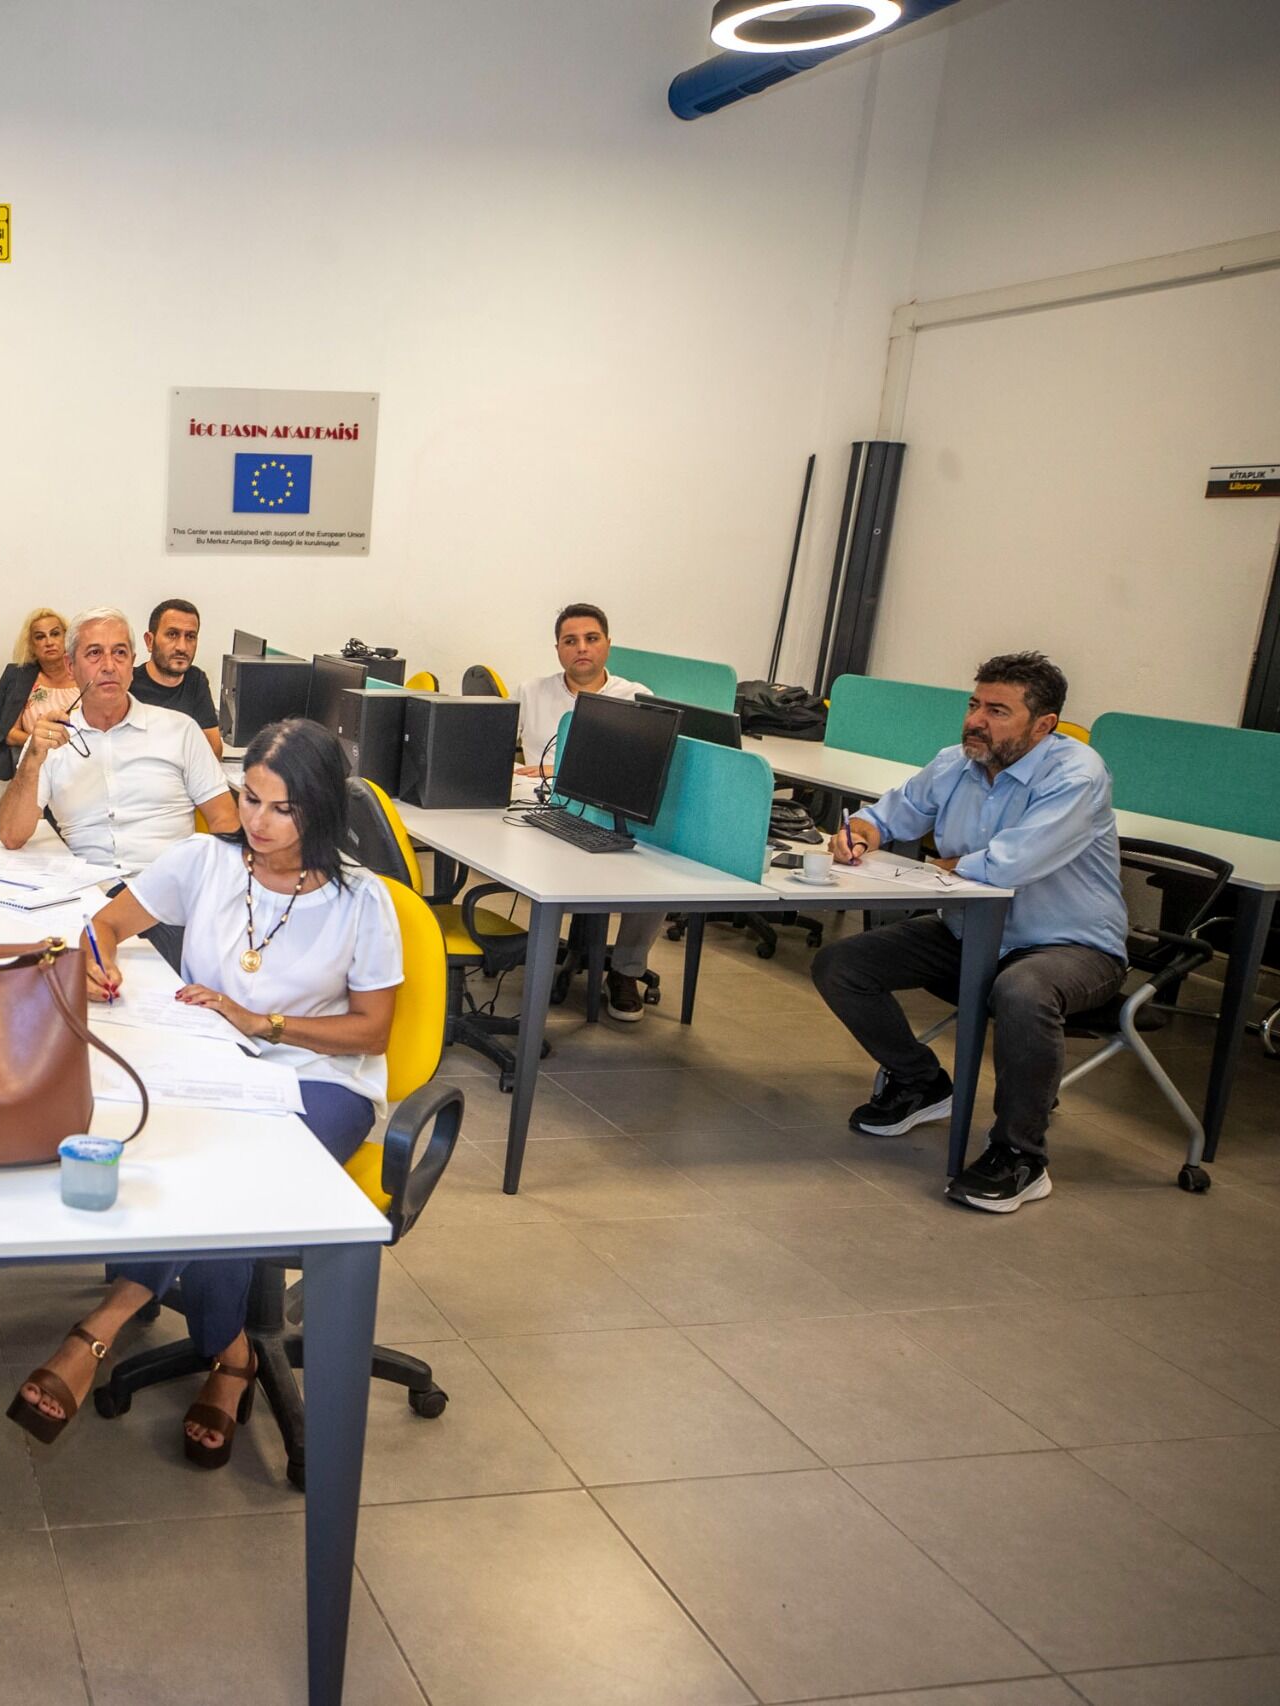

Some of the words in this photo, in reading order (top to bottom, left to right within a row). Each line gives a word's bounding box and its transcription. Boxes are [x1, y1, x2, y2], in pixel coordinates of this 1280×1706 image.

[189, 418, 218, 437] İGC
[220, 423, 268, 438] BASIN
[271, 422, 359, 441] AKADEMİSİ
[1229, 470, 1266, 479] KİTAPLIK
[1229, 482, 1262, 492] Library
[173, 527, 186, 535] This
[273, 530, 297, 538] support
[316, 530, 347, 539] European
[196, 537, 206, 545] Bu
